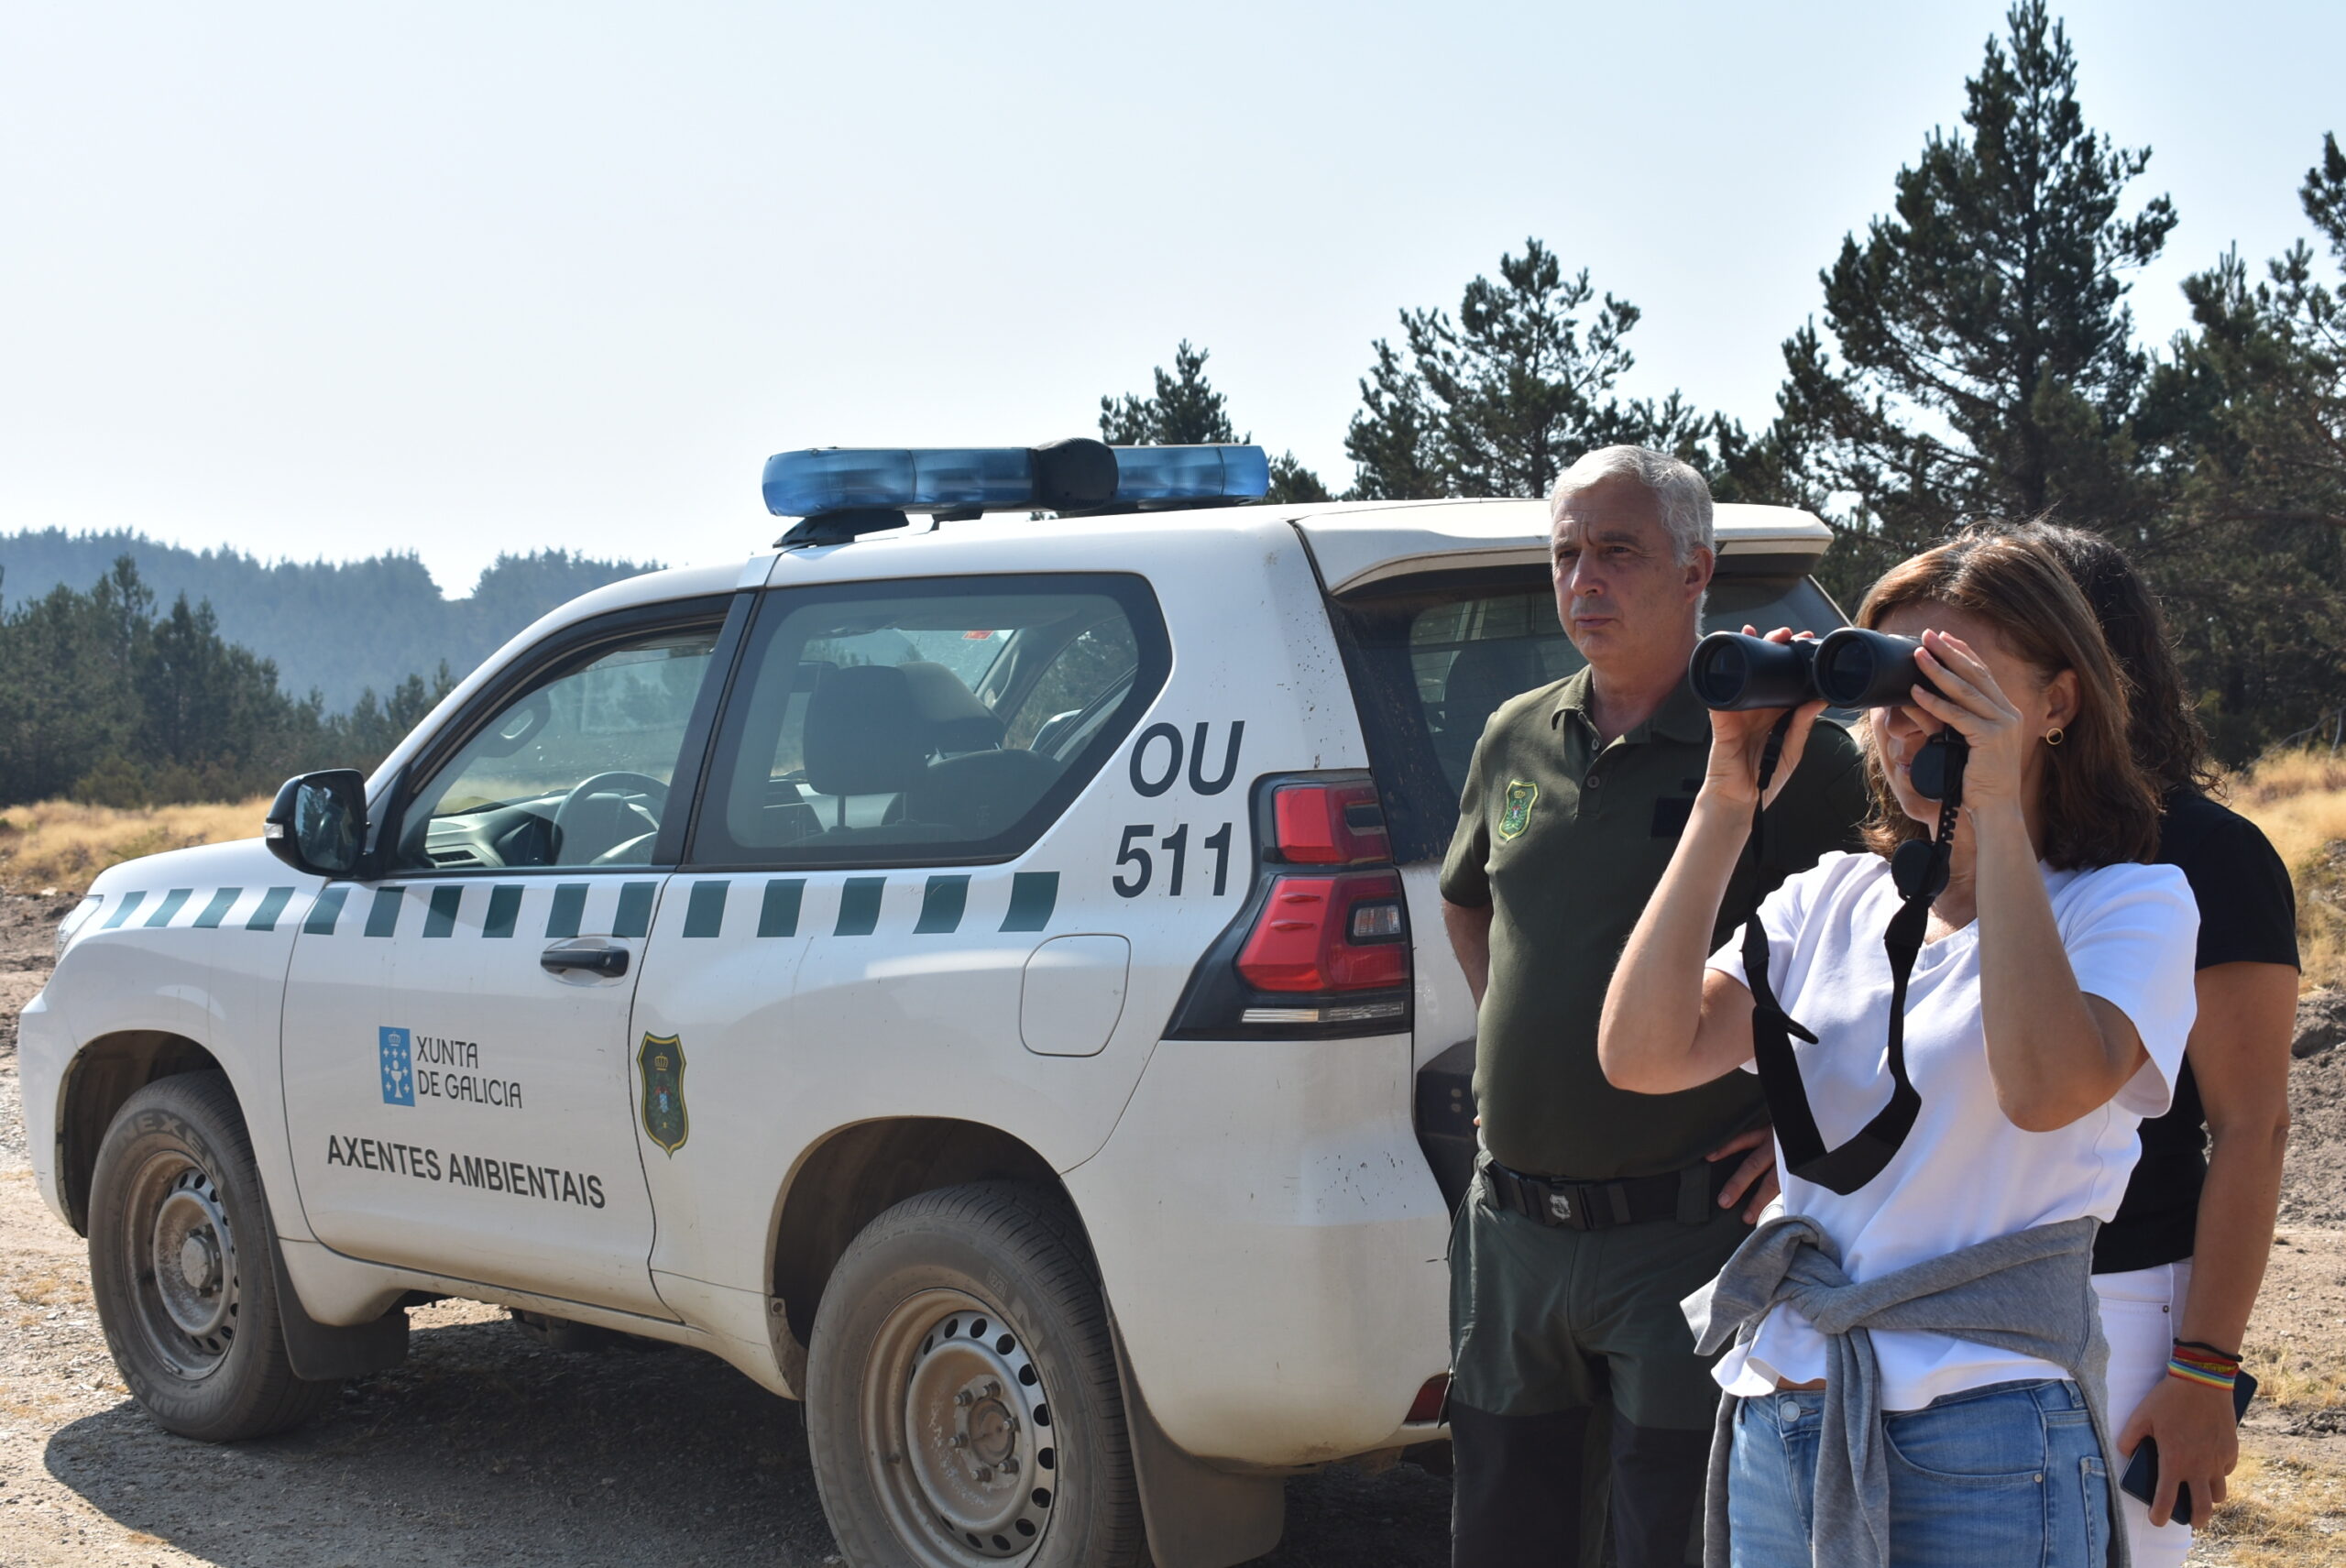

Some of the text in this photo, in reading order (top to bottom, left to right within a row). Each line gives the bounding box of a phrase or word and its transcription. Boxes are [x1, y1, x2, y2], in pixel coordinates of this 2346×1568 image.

[1128, 719, 1245, 798] OU
[1112, 822, 1233, 899] 511
[416, 1036, 479, 1069] XUNTA
[417, 1069, 522, 1109] DE GALICIA
[115, 1112, 226, 1192] NEXEN
[327, 1135, 606, 1209] AXENTES AMBIENTAIS
